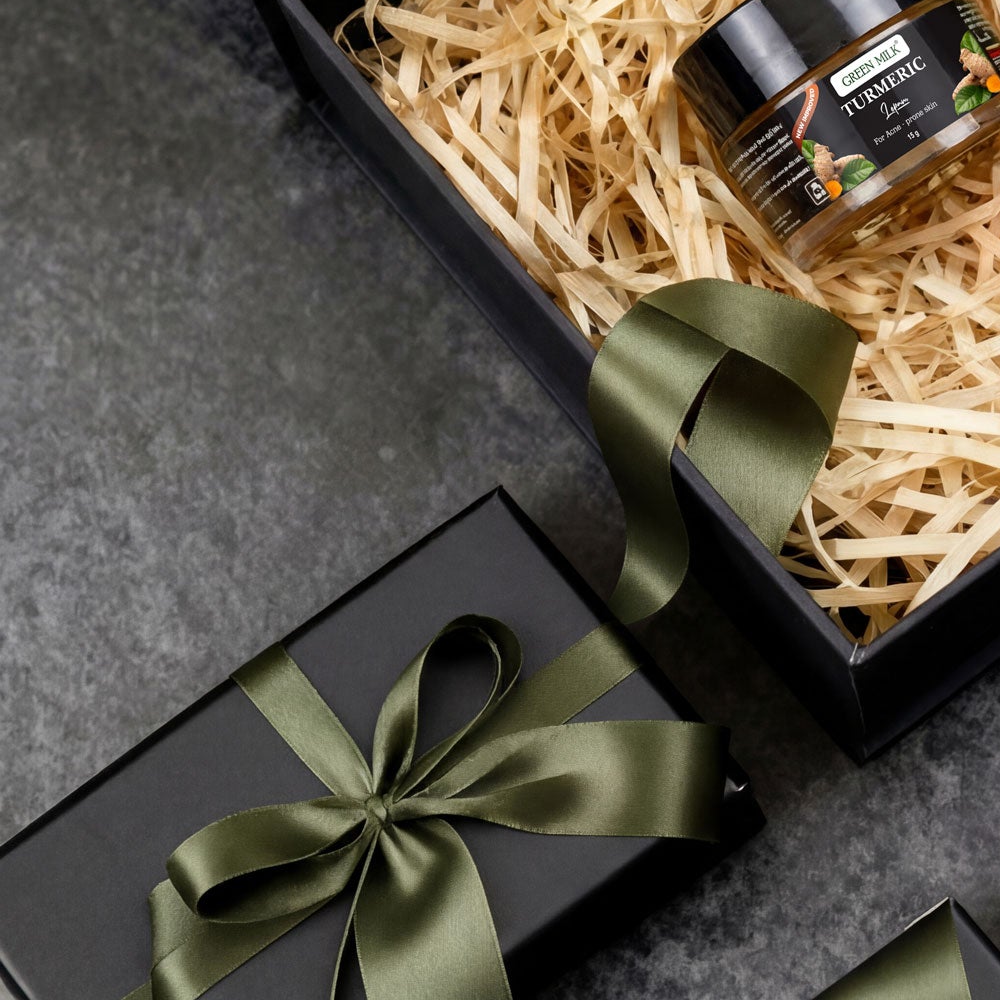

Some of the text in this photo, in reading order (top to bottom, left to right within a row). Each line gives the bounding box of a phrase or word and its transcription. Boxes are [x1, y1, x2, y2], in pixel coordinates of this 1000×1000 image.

[840, 56, 927, 118] TURMERIC
[841, 60, 876, 87] GREEN
[795, 88, 815, 139] NEW IMPROVED
[873, 135, 885, 146] For
[885, 124, 902, 138] Acne
[905, 110, 925, 127] prone
[923, 101, 938, 113] skin
[907, 130, 921, 140] 15 g
